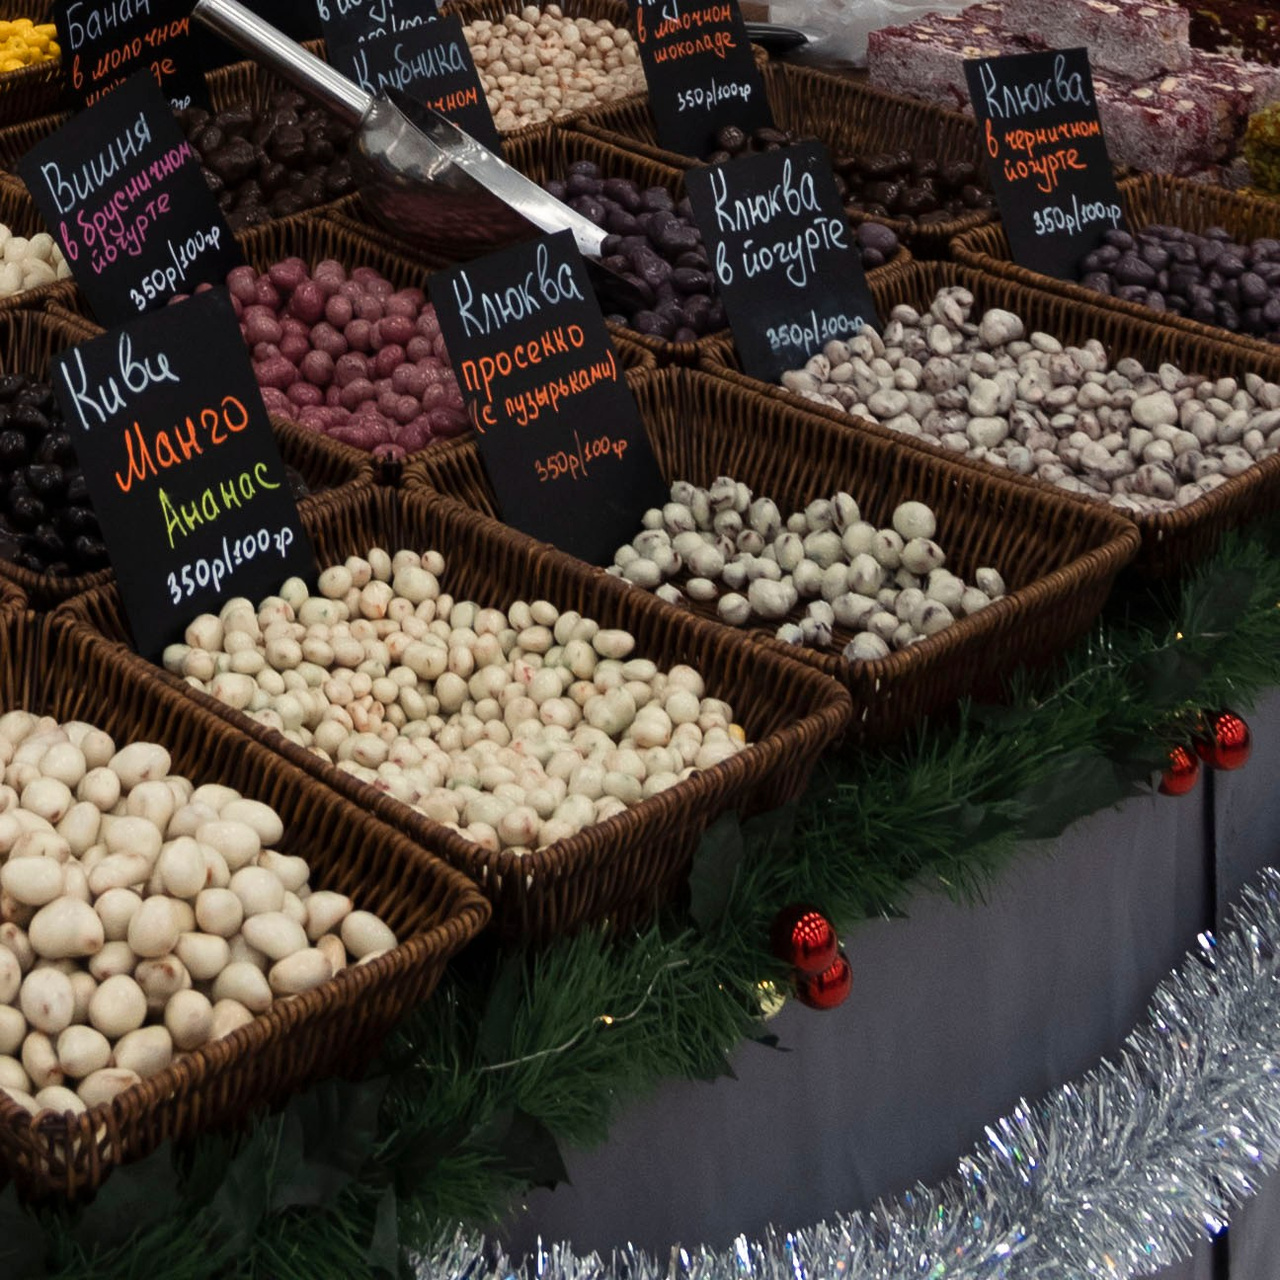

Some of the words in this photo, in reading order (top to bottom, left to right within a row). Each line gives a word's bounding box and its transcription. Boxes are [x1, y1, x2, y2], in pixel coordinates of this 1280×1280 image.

[637, 6, 647, 44] в
[654, 31, 737, 64] шоколаде
[73, 54, 84, 89] в
[353, 42, 468, 96] Клубника
[979, 54, 1091, 118] Клюква
[40, 112, 152, 215] Вишня
[985, 118, 999, 159] в
[1005, 120, 1101, 158] черничном
[1004, 148, 1088, 193] йогурте
[60, 221, 78, 262] в
[77, 140, 191, 247] брусничном
[710, 158, 822, 232] Клюква
[92, 192, 170, 275] йогурте
[716, 241, 733, 285] в
[743, 218, 848, 287] йогурте
[452, 243, 585, 338] Клюква
[60, 331, 180, 431] Киви
[462, 324, 585, 403] просекко
[505, 349, 617, 427] пузырьками)
[115, 395, 249, 493] Манго
[158, 462, 281, 549] Ананас
